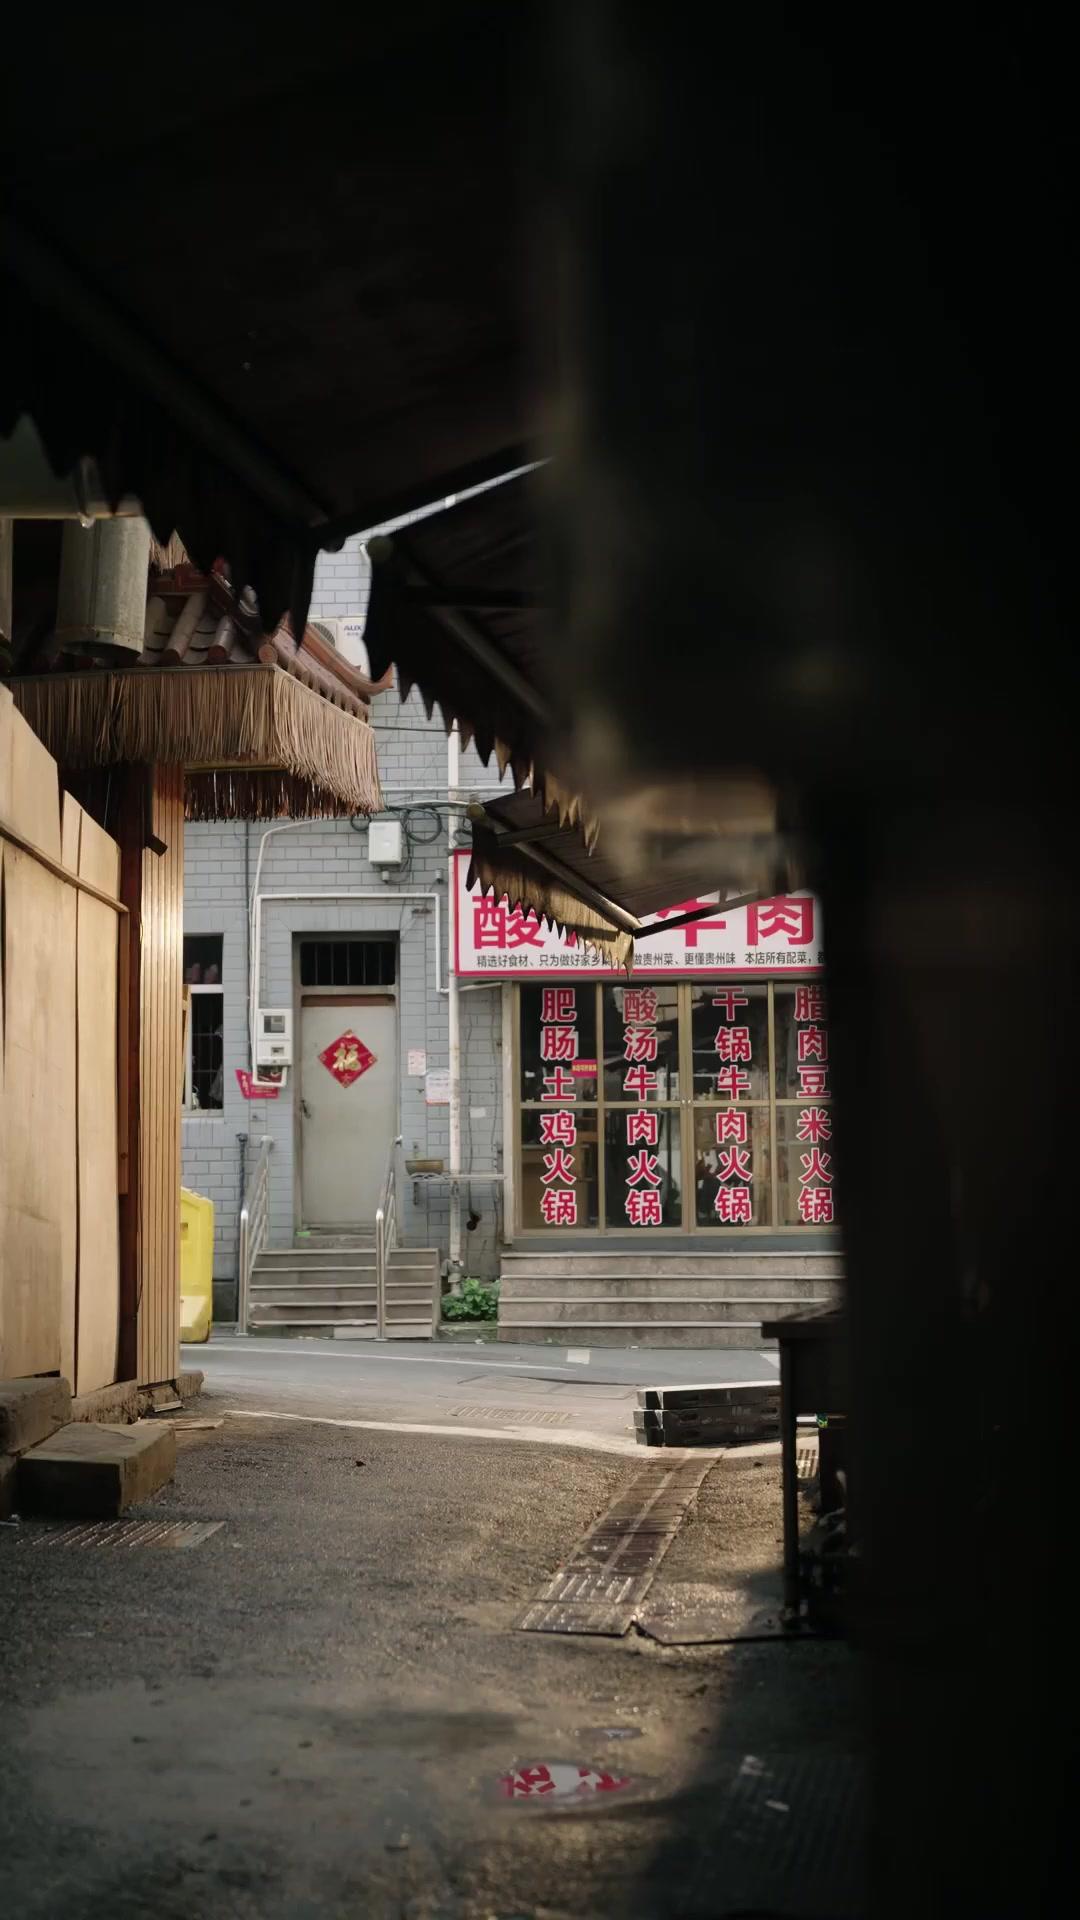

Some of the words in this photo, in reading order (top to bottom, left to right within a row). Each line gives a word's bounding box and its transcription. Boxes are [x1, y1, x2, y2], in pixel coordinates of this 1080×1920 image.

[472, 893, 815, 949] 酸牛肉
[540, 987, 577, 1225] 肥肠土鸡火锅
[622, 987, 662, 1225] 酸汤牛肉火锅
[713, 986, 752, 1223] 干锅牛肉火锅
[794, 986, 834, 1223] 腊肉豆米火锅
